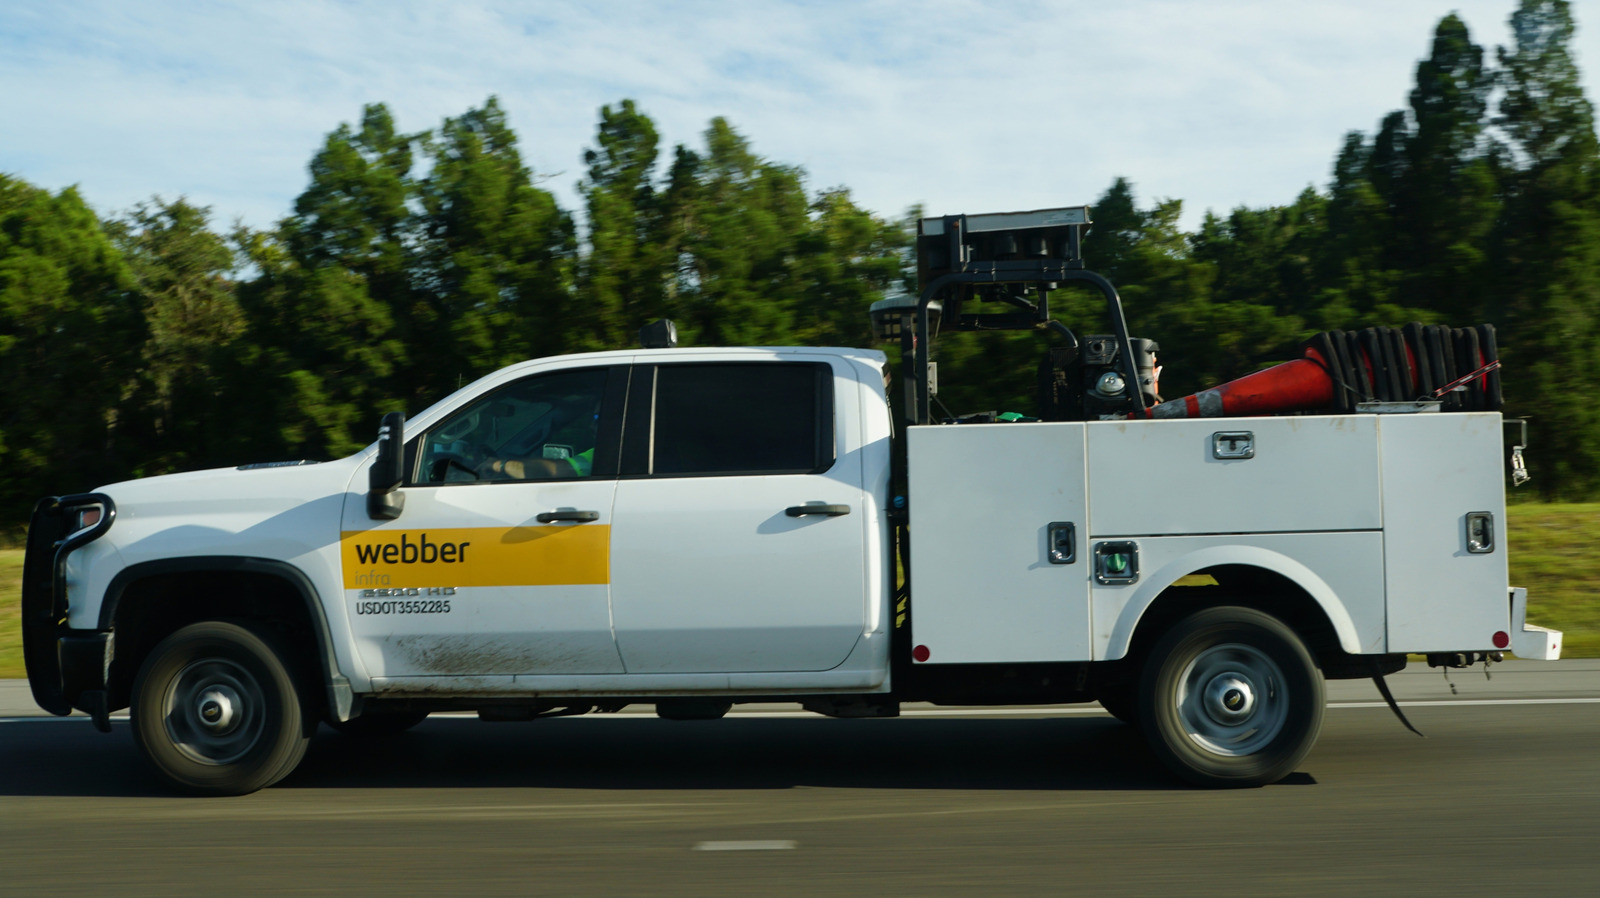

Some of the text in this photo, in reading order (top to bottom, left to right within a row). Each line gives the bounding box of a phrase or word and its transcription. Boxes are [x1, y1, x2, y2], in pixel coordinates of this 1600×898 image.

[355, 533, 470, 564] webber
[355, 569, 391, 585] infra
[356, 600, 451, 615] USDOT3552285
